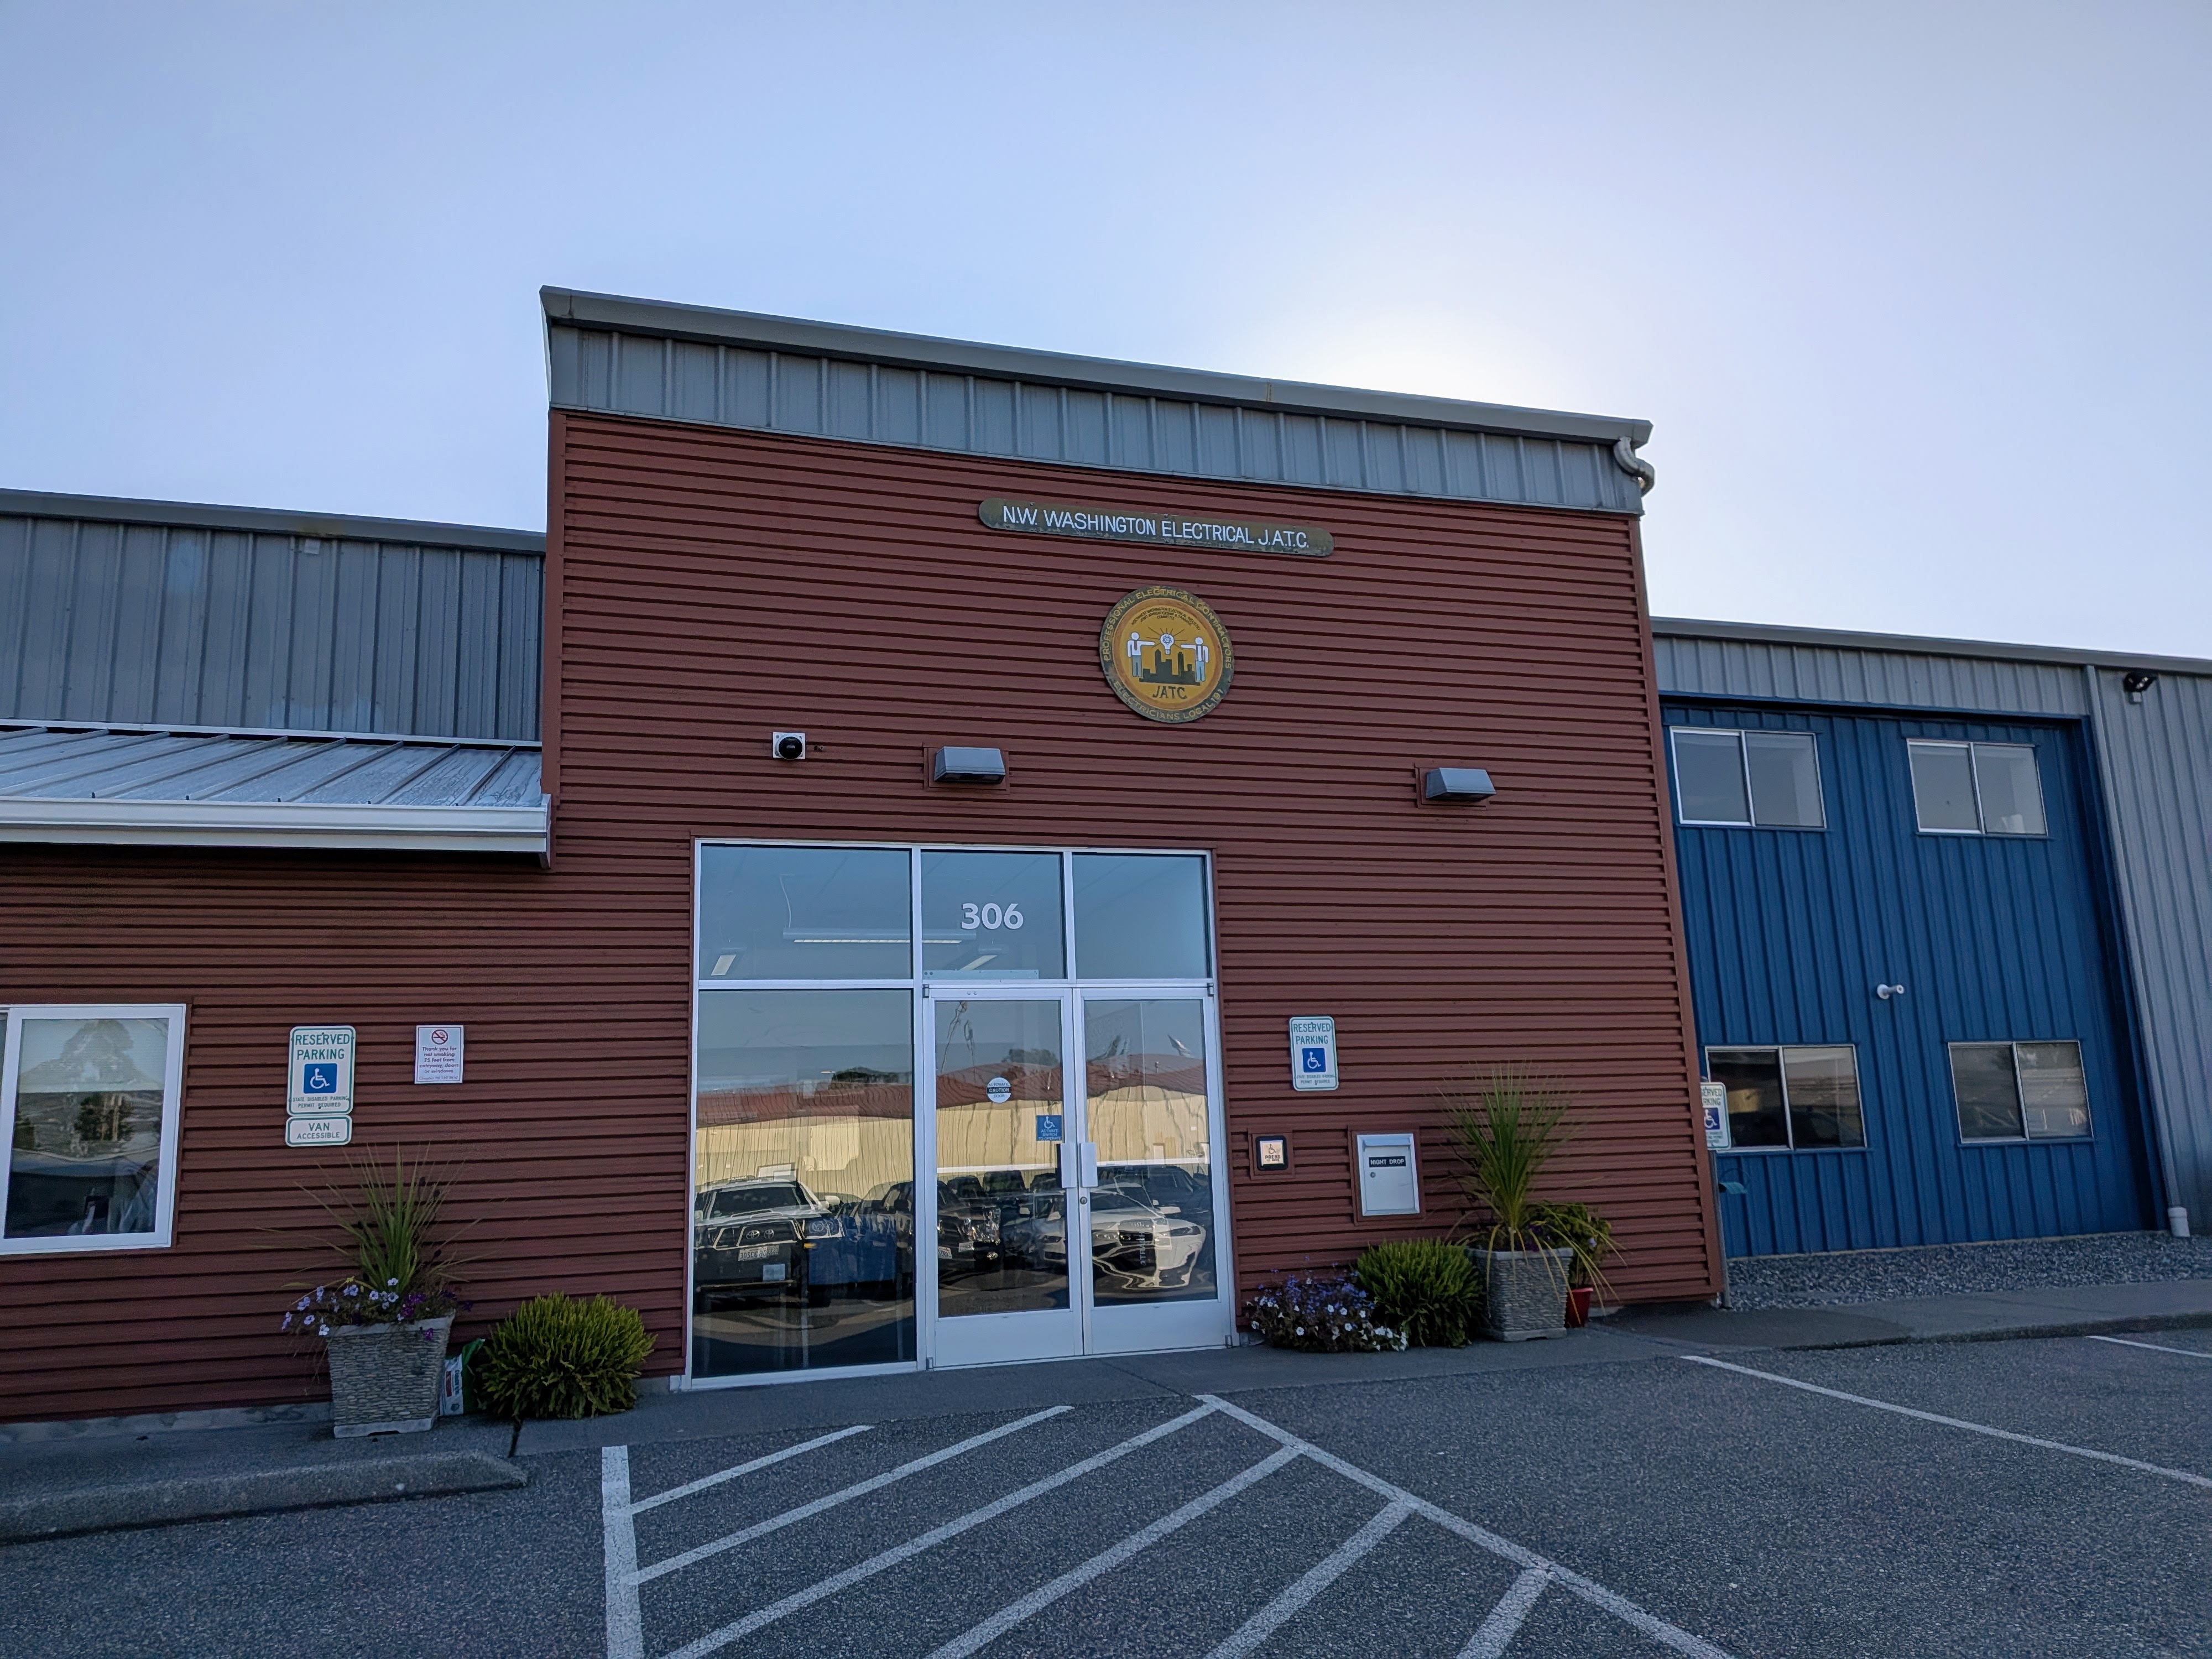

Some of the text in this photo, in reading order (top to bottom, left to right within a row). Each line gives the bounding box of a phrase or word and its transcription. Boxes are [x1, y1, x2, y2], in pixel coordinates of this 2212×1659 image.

[1003, 505, 1037, 525] N.W.
[1044, 510, 1156, 536] WASHINGTON
[1162, 520, 1254, 544] ELECTRICAL
[1103, 588, 1232, 669] PROFESSIONAL ELECTRICAL CONTRACTORS
[1152, 685, 1187, 699] JATC
[1113, 681, 1224, 720] ELECTRICIANS LOCAL 191
[961, 902, 1024, 930] 306
[1293, 1022, 1331, 1032] RESERVED
[295, 1034, 350, 1045] RESERVED
[1296, 1035, 1329, 1045] PARKING
[297, 1048, 345, 1060] PARKING
[309, 1123, 330, 1131] VAN
